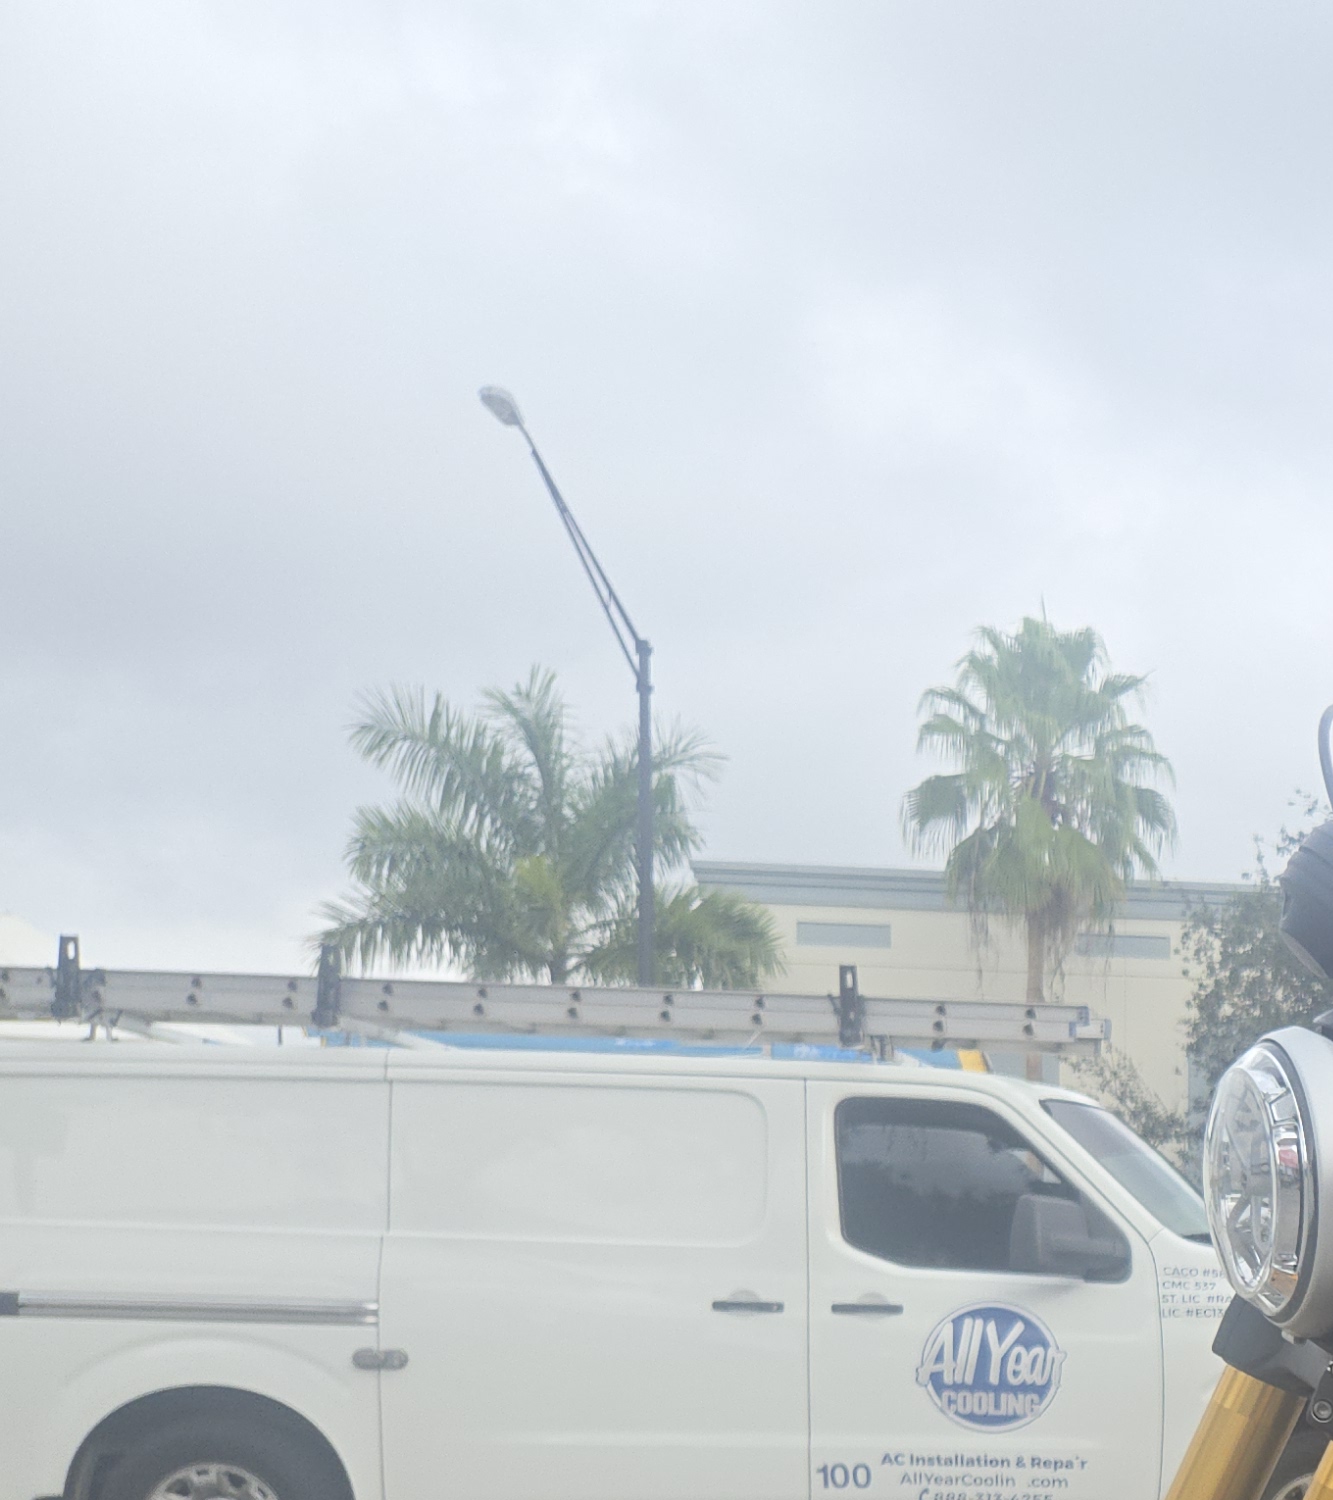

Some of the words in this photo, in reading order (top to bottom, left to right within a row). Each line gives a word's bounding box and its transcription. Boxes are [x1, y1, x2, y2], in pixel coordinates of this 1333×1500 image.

[1162, 1281, 1191, 1290] CMC
[1162, 1308, 1181, 1319] LIC
[941, 1389, 1042, 1418] COOLING
[881, 1453, 906, 1467] AC
[910, 1453, 1011, 1469] Installation
[1015, 1456, 1027, 1469] &
[816, 1463, 872, 1489] 100
